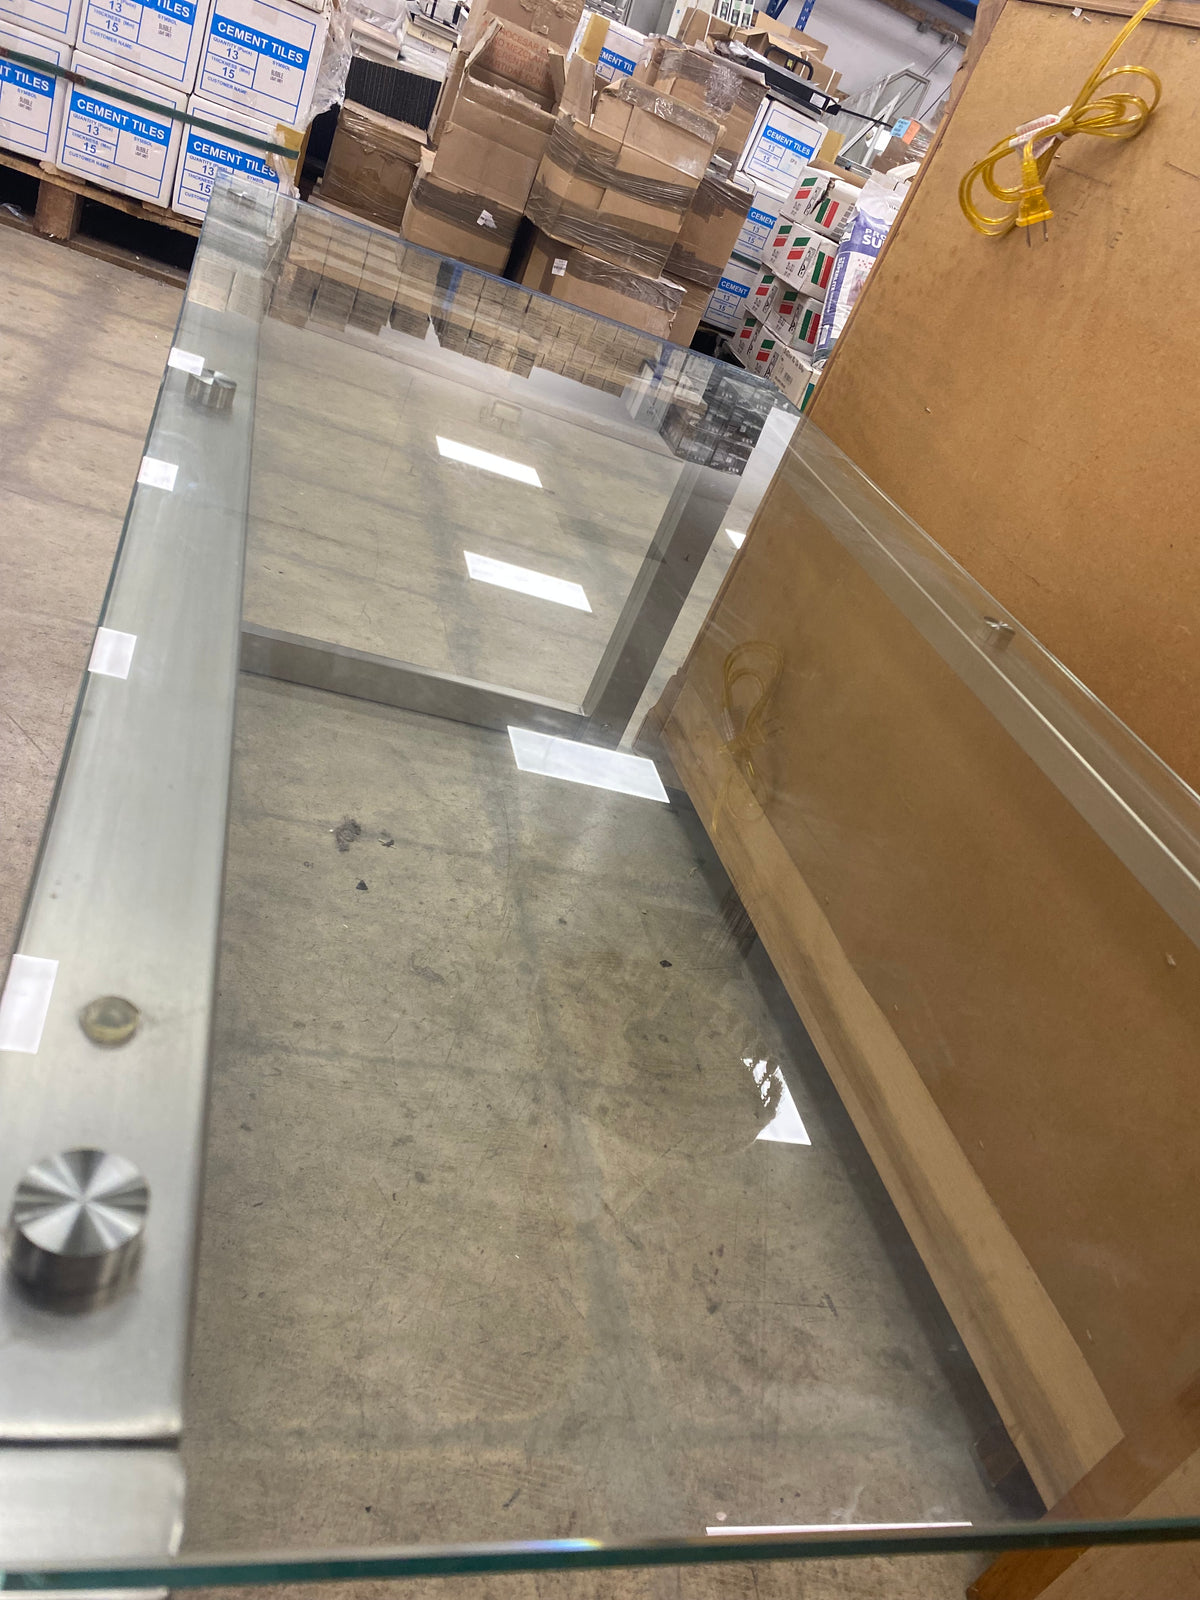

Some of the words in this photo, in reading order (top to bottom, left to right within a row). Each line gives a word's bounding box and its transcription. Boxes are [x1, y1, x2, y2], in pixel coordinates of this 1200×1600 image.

[109, 0, 122, 13] 13
[105, 20, 119, 33] 15
[212, 36, 237, 49] QUANTITY
[217, 21, 269, 49] CEMENT
[271, 42, 304, 64] TILES
[226, 48, 239, 60] 13
[222, 66, 235, 79] 15
[14, 69, 49, 91] TILES
[73, 113, 97, 125] QUANTITY
[77, 99, 129, 126] CEMENT
[132, 119, 165, 140] TILES
[87, 124, 99, 136] 13
[83, 142, 97, 154] 15
[766, 129, 793, 146] CEMENT
[793, 142, 811, 156] TILES
[768, 144, 775, 153] 13
[193, 141, 243, 165] CEMENT
[245, 158, 276, 178] TILES
[763, 154, 770, 163] 15
[202, 165, 214, 177] 13
[198, 182, 211, 194] 15
[750, 211, 774, 226] CEMEN
[752, 225, 760, 233] 13
[865, 228, 887, 240] PRO
[747, 236, 755, 244] 15
[862, 235, 882, 249] SU
[721, 280, 747, 295] CEMENT
[719, 304, 726, 312] 15
